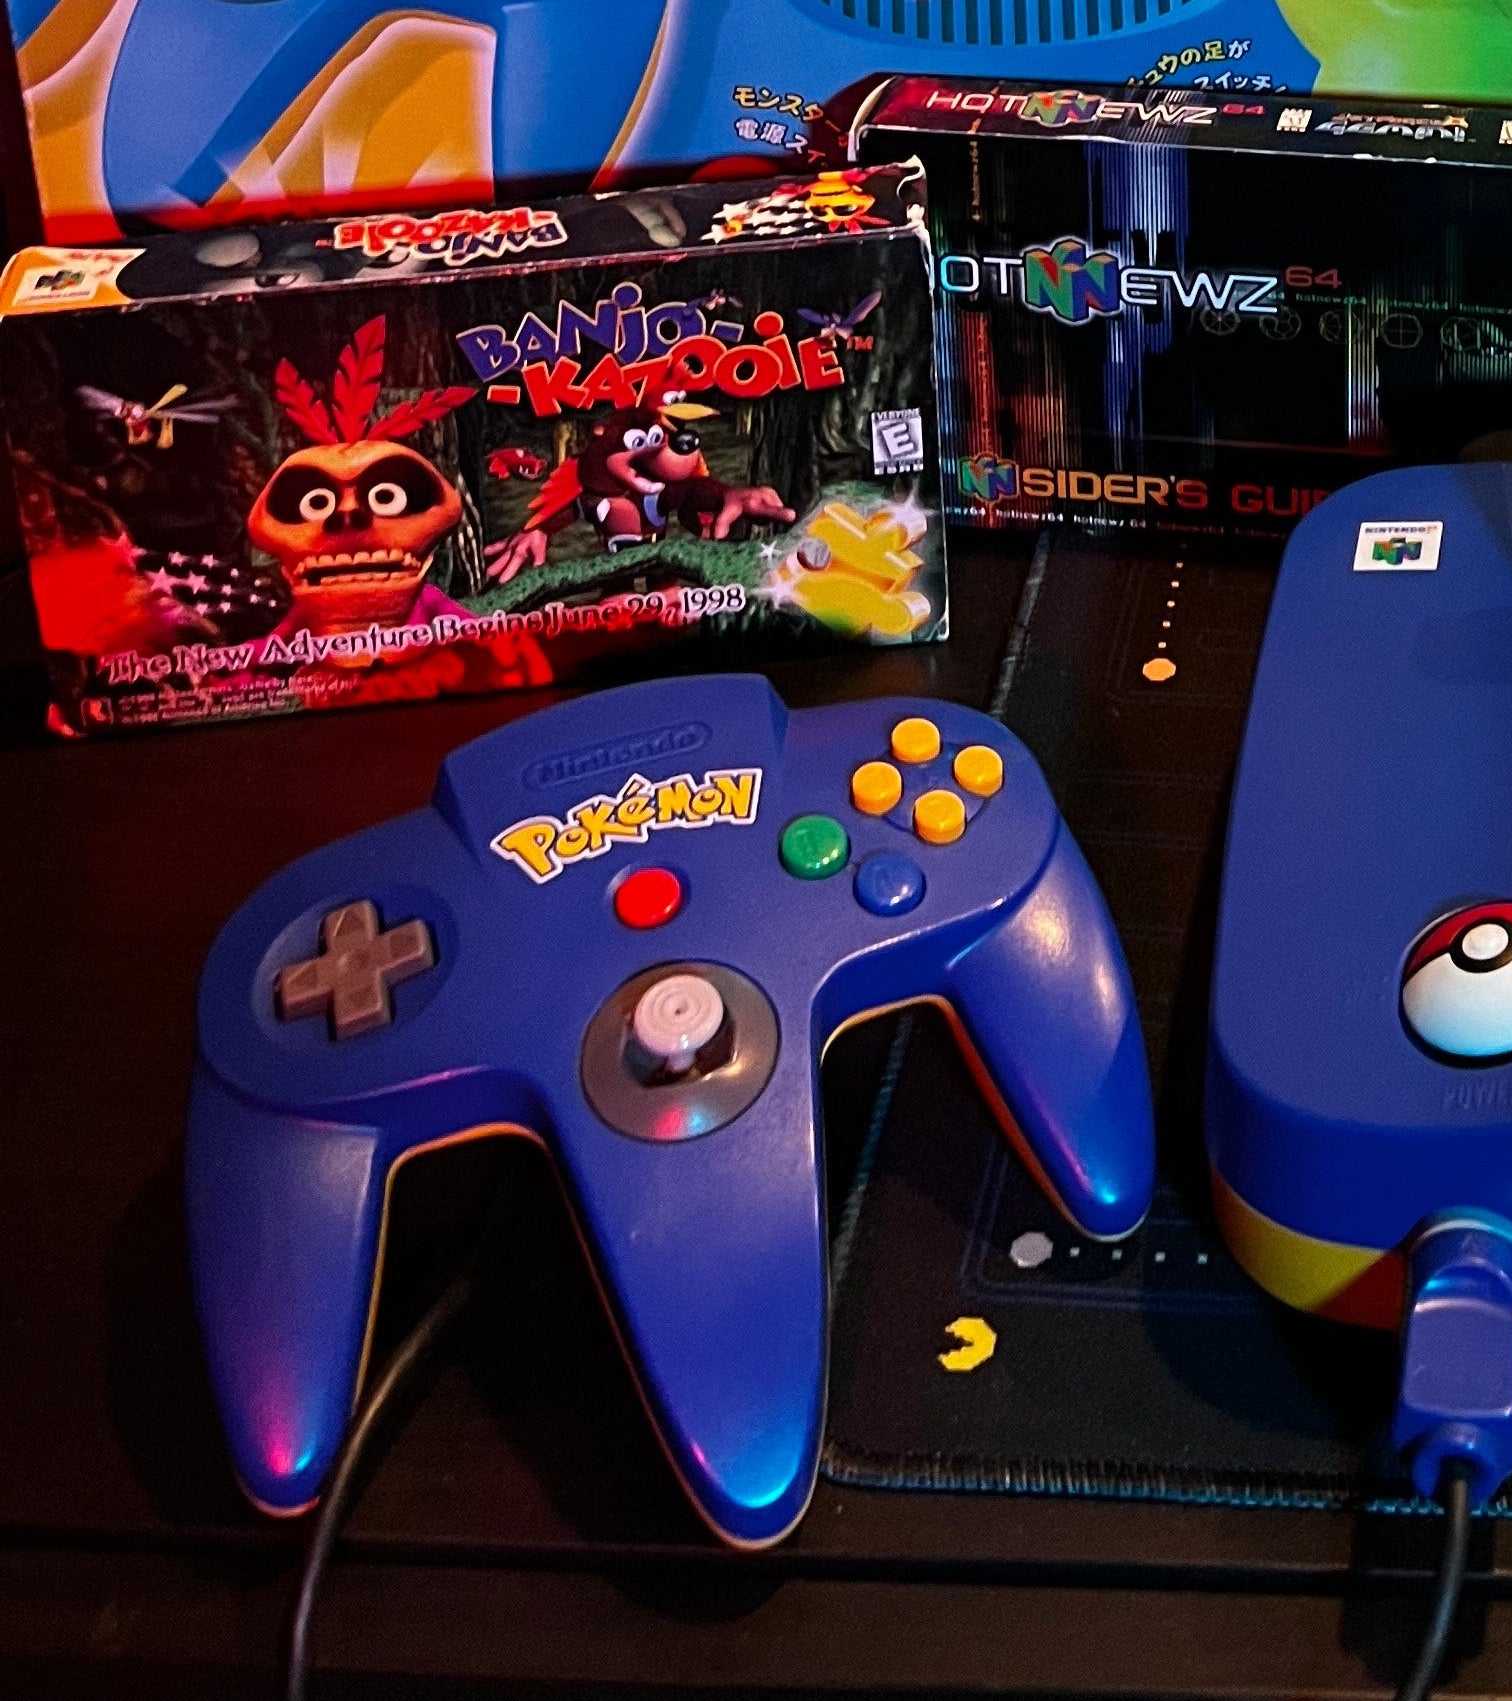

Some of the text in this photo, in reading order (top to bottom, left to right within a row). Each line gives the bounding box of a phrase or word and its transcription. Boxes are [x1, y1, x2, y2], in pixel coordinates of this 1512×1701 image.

[735, 119, 826, 165] 電源スイ
[940, 239, 1342, 322] OTNEWZ 64
[879, 421, 917, 458] E
[1231, 481, 1331, 518] GUI
[102, 649, 172, 686] The
[173, 639, 255, 678] New
[259, 622, 432, 669] Adventure
[433, 605, 544, 648] Begins
[545, 602, 623, 642] June
[681, 585, 747, 617] 1998
